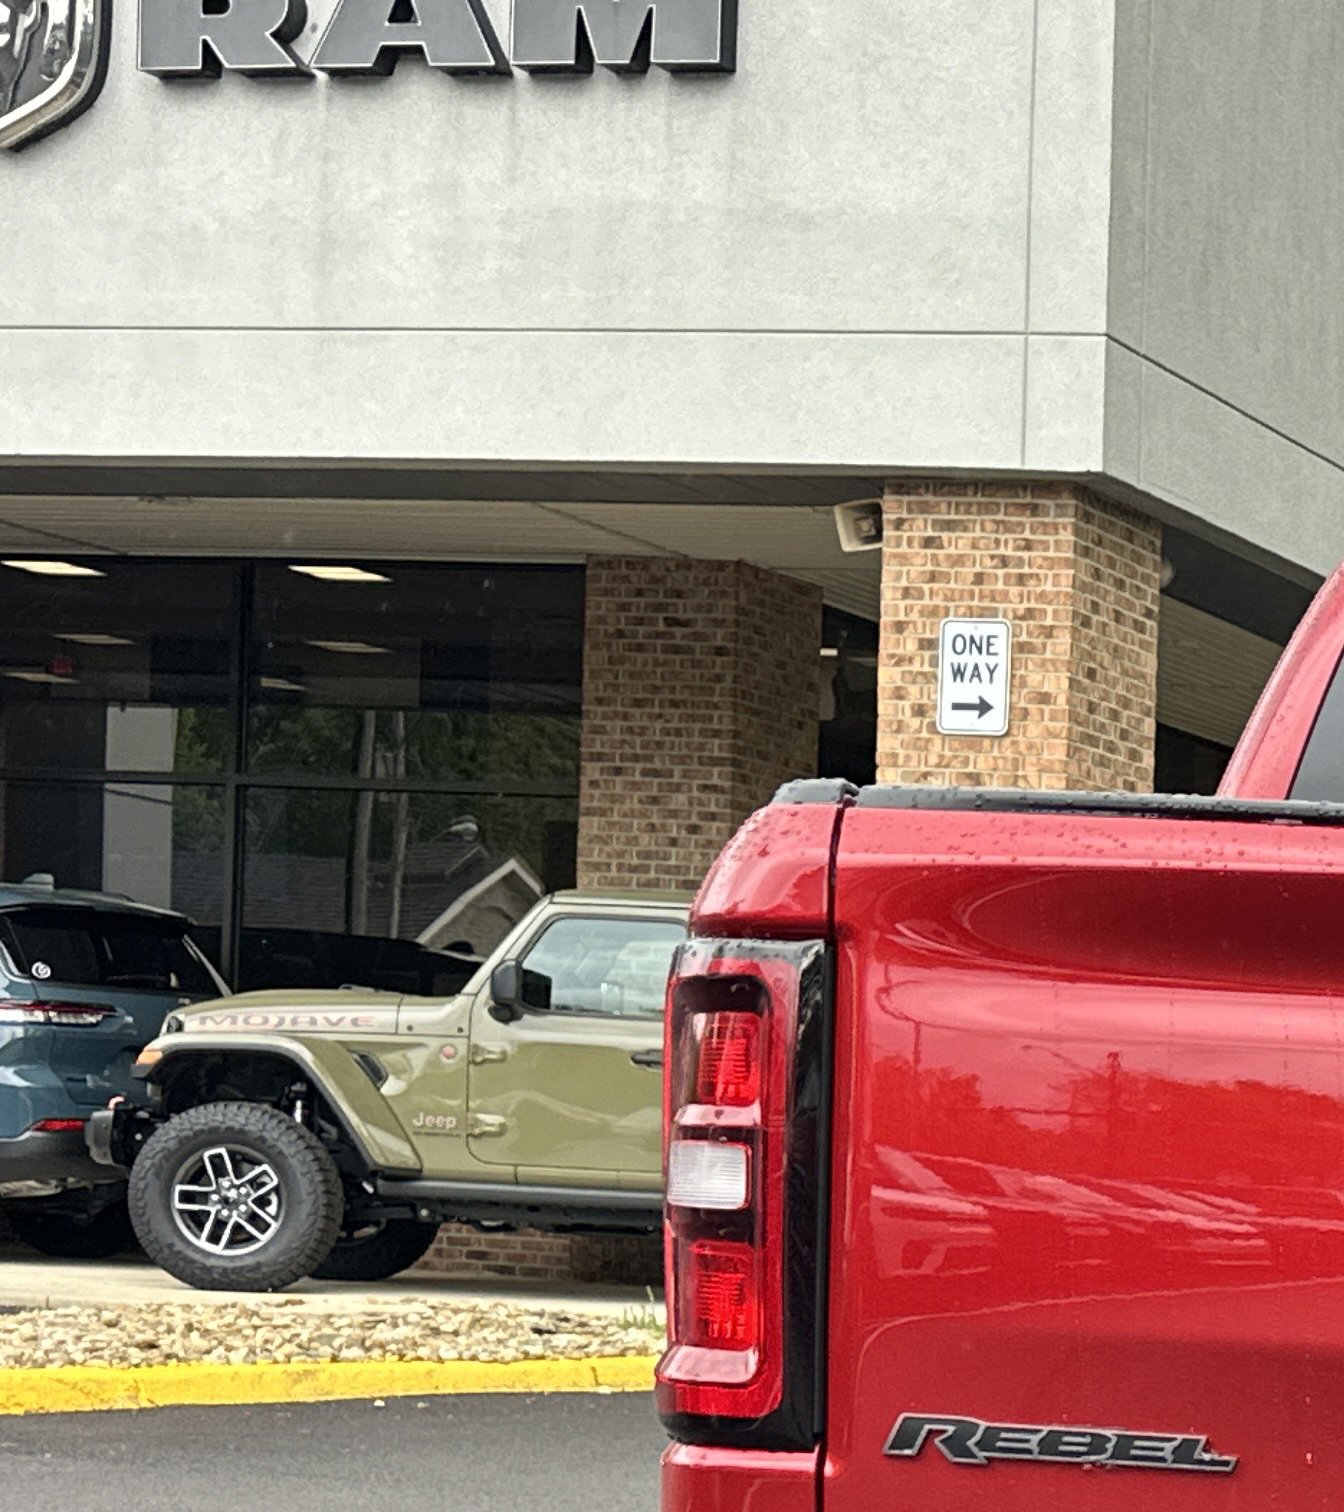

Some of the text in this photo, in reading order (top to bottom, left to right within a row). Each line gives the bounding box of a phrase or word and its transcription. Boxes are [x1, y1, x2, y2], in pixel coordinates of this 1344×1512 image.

[137, 0, 737, 76] RAM
[951, 633, 999, 656] ONE
[950, 662, 999, 684] WAY
[199, 1012, 375, 1029] MOJAVE
[412, 1112, 457, 1130] Jeep
